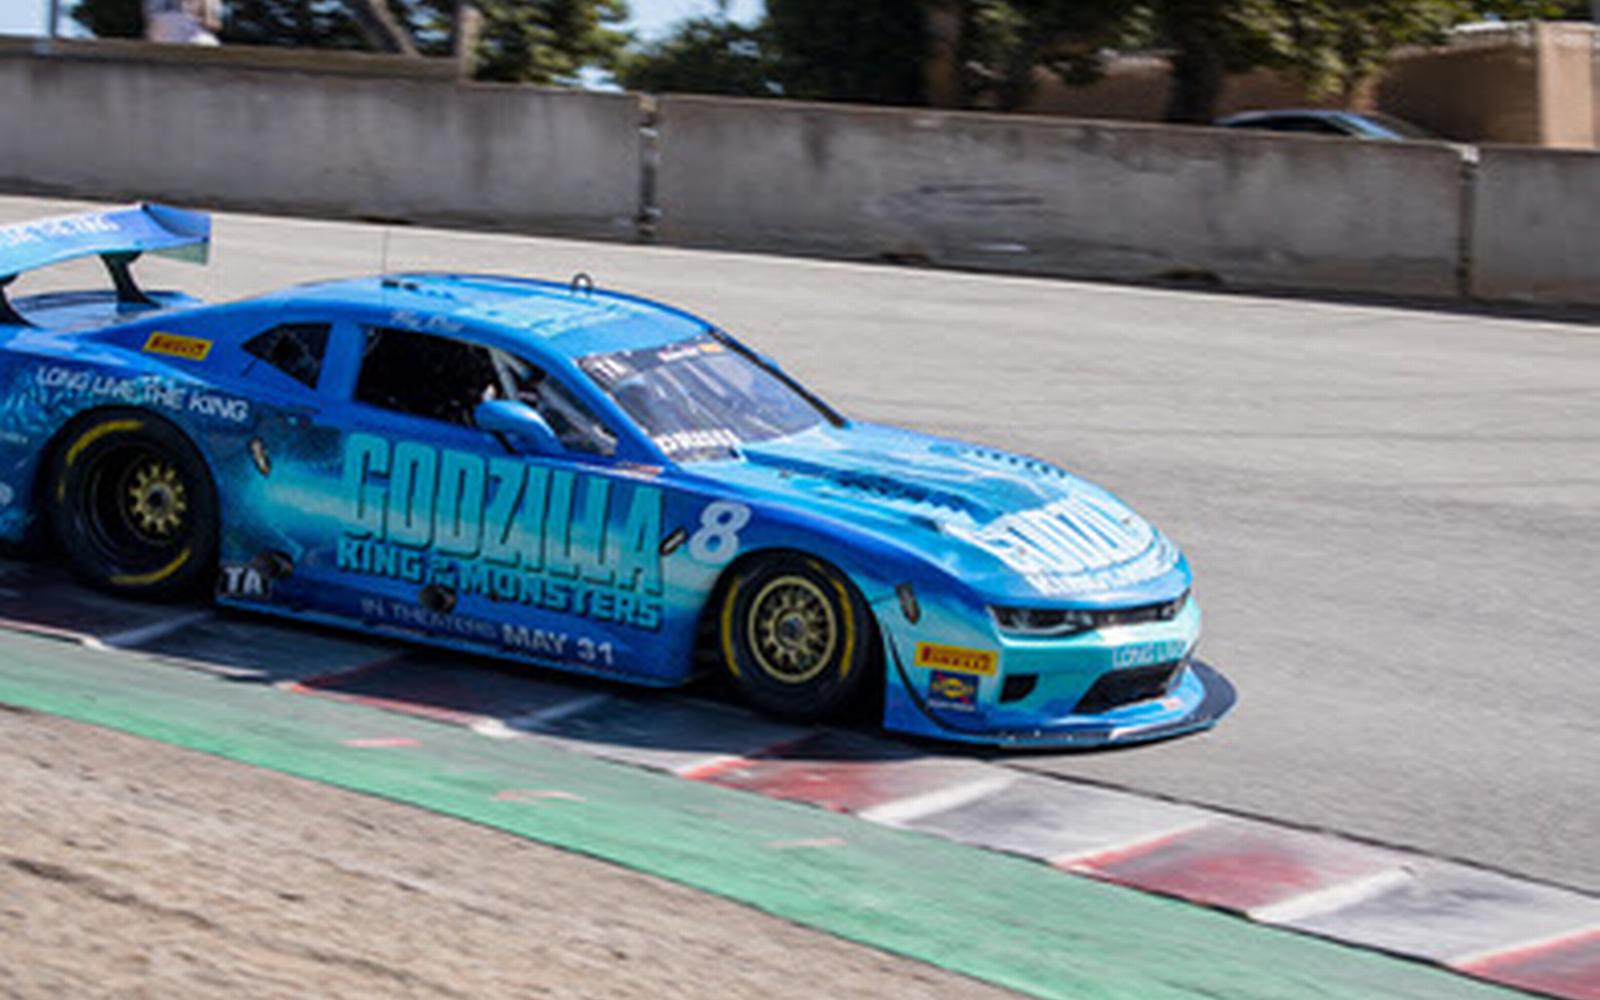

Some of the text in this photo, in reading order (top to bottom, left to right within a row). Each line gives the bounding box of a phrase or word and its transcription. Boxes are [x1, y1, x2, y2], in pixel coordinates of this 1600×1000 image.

[35, 366, 249, 422] LONG LIVE THE KING
[343, 432, 664, 595] GODZILLA
[689, 500, 751, 566] 8
[224, 566, 263, 595] TA
[336, 537, 424, 584] KING
[454, 564, 663, 630] MONSTERS
[502, 623, 568, 655] MAY
[576, 637, 615, 665] 31
[921, 645, 992, 673] PIRELLI
